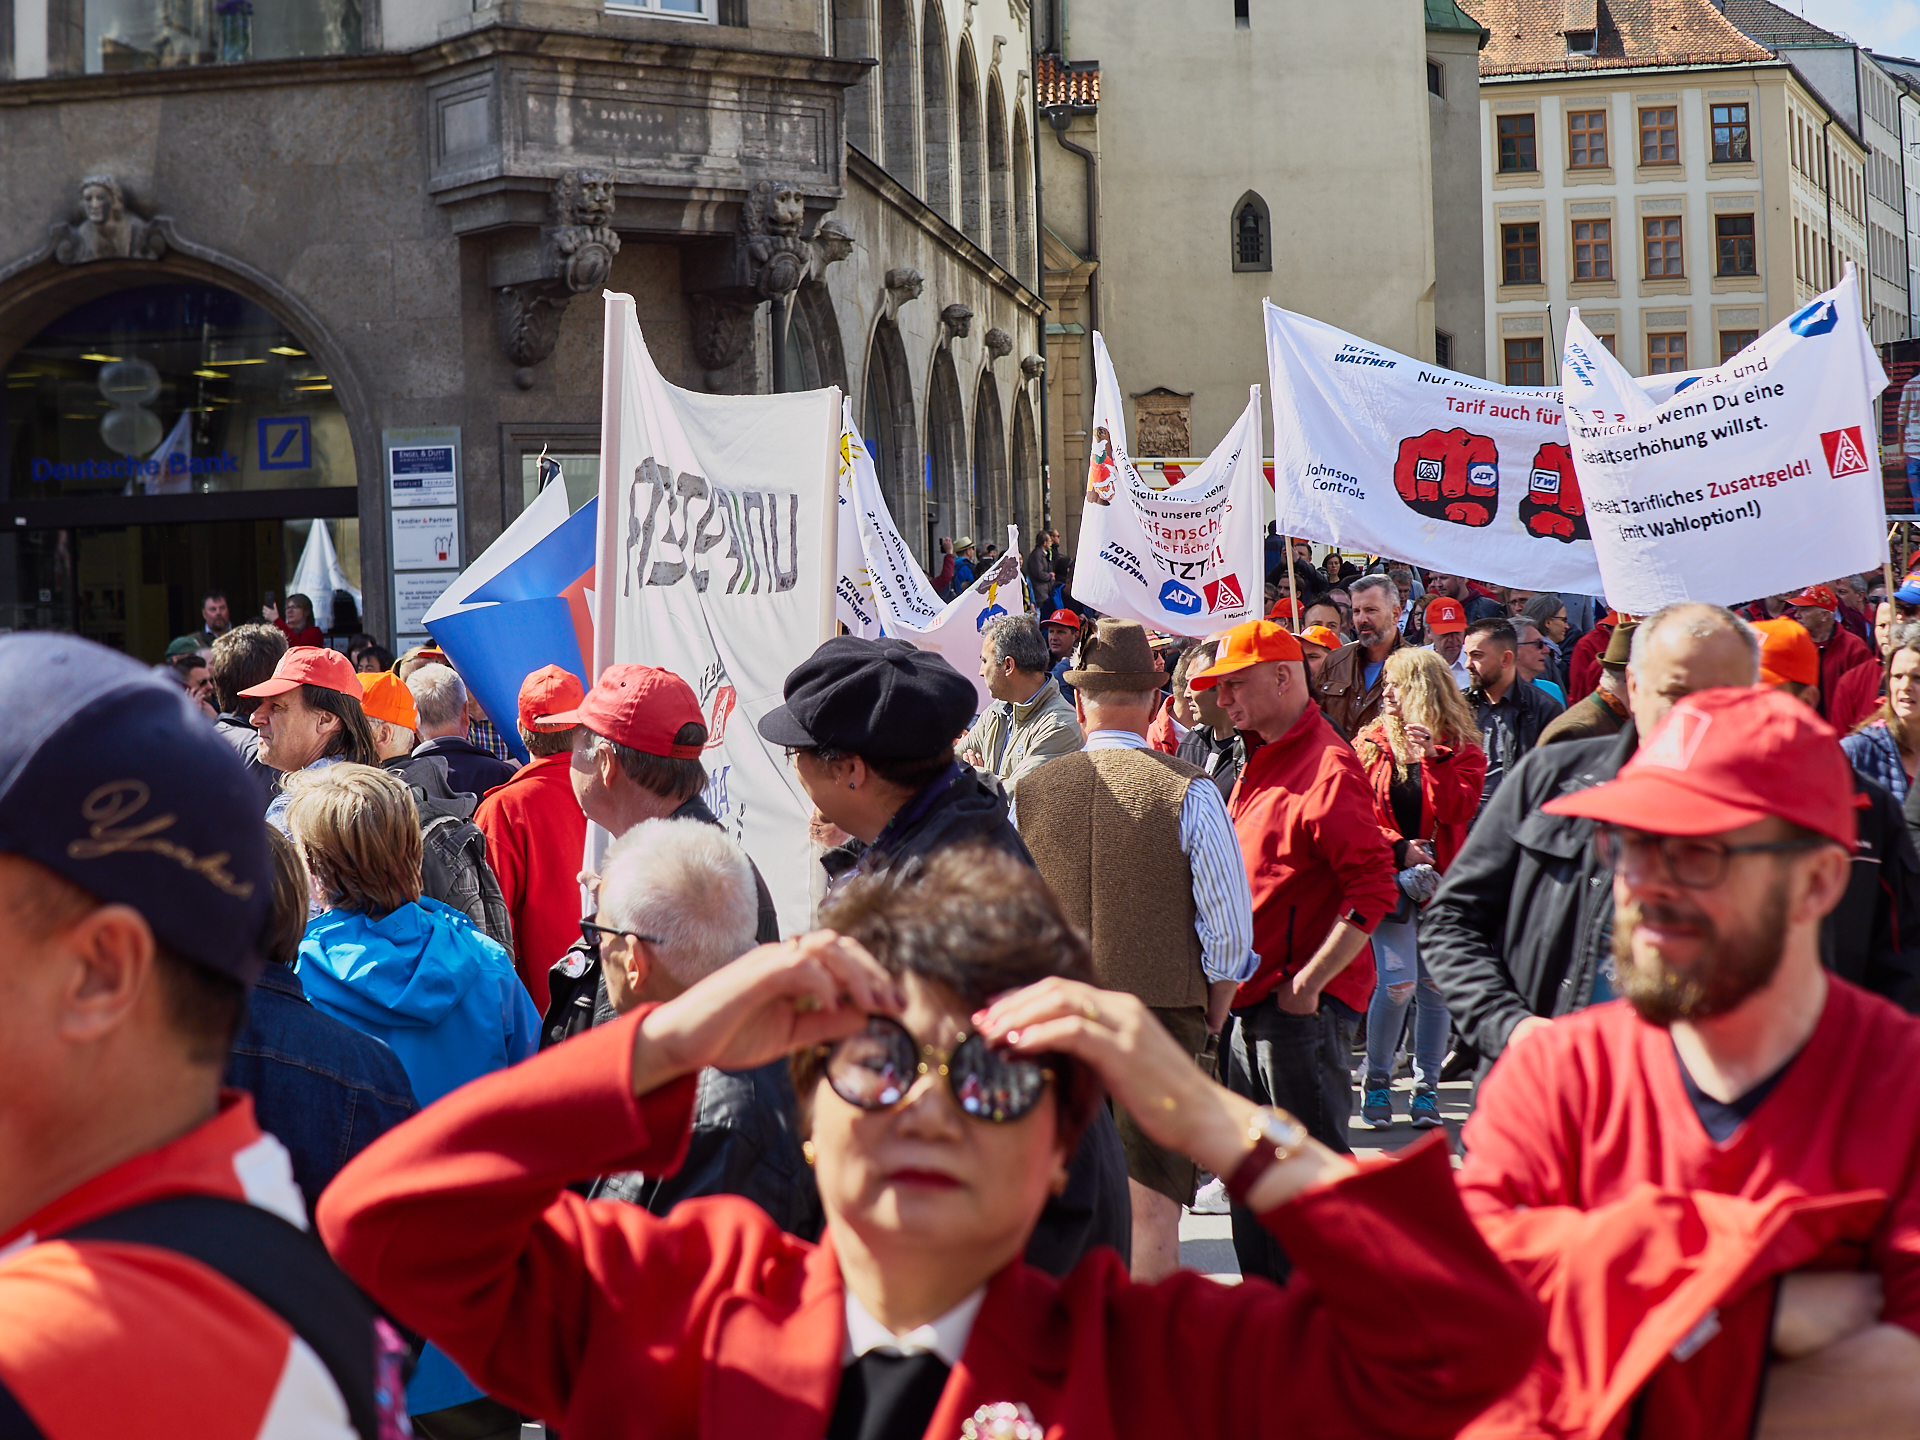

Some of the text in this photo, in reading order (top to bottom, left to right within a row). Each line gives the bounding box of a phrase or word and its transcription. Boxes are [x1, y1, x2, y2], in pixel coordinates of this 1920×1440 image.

[1333, 354, 1397, 370] WALTHER
[1341, 343, 1382, 357] TOTAL
[1568, 343, 1597, 371] TOTAL
[1417, 370, 1451, 386] Nur
[1563, 353, 1595, 387] ALTHER
[1733, 356, 1769, 380] und
[1446, 396, 1486, 415] Tarif
[1489, 404, 1531, 422] auch
[1536, 407, 1563, 426] für
[1656, 402, 1708, 425] wenn
[1713, 395, 1740, 411] Du
[1744, 383, 1785, 404] eine
[1711, 416, 1768, 440] willst.
[30, 449, 240, 482] Deutsche Bank
[1115, 445, 1140, 488] Wir sind
[1306, 464, 1358, 485] Johnson
[1474, 471, 1494, 481] ADT
[1312, 478, 1365, 500] Controls
[1536, 475, 1556, 486] TW
[1621, 489, 1704, 514] Tarifliches
[1707, 459, 1813, 498] Zusatzgeld!
[1161, 510, 1202, 520] unsere
[1619, 500, 1761, 541] (mit Wahloption!)
[1108, 541, 1141, 568] TOTAL
[1155, 541, 1169, 553] die
[1173, 542, 1210, 556] Fläche
[1100, 551, 1148, 587] WALTHER
[839, 575, 865, 606] TOTAL
[1165, 589, 1196, 607] ADT
[836, 585, 872, 626] WALTHER
